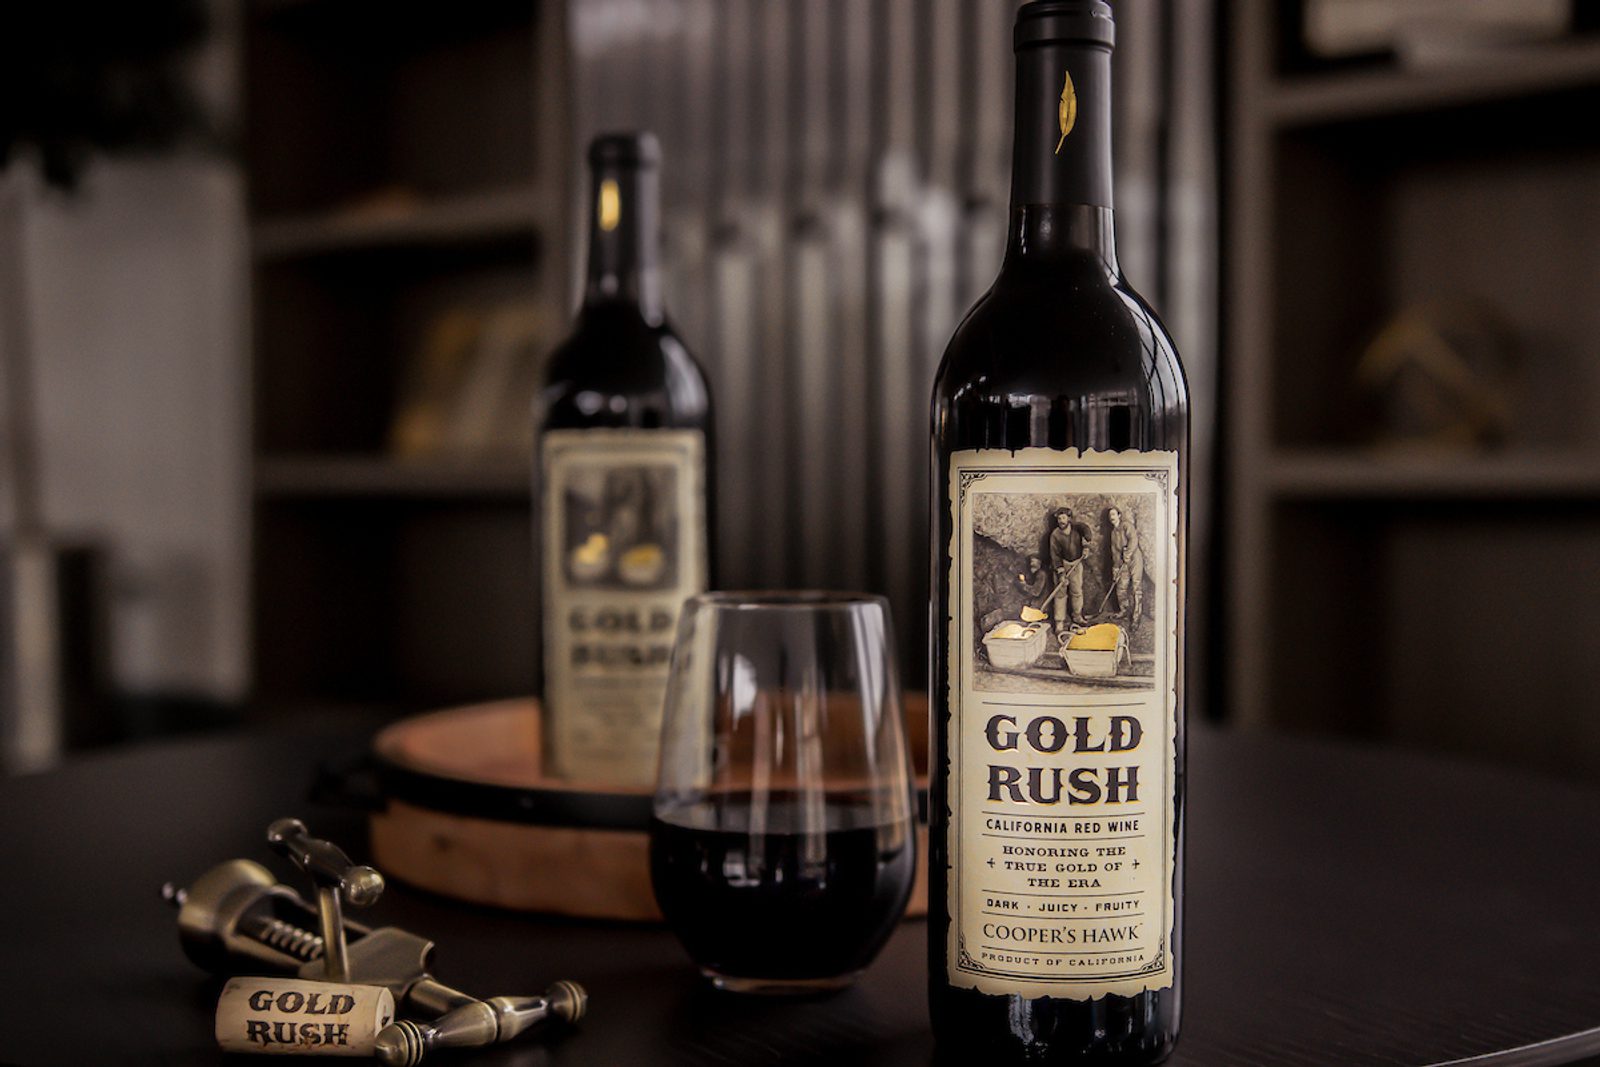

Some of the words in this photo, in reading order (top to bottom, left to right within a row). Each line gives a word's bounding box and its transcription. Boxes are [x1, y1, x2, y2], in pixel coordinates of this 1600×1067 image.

[984, 714, 1144, 753] GOLD
[986, 764, 1140, 805] RUSH
[986, 818, 1068, 834] CALIFORNIA
[1074, 822, 1101, 833] RED
[1108, 820, 1139, 832] WINE
[1002, 845, 1090, 857] HONORING
[1096, 846, 1126, 856] THE
[1004, 861, 1047, 872] TRUE
[1055, 863, 1097, 873] GOLD
[1104, 862, 1123, 871] OF
[1028, 878, 1060, 888] THE
[1068, 878, 1102, 888] ERA
[987, 898, 1019, 910] DARK
[1039, 903, 1078, 912] JUICY
[1096, 900, 1140, 912] FRUITY
[983, 923, 1076, 944] COOPER'S
[1083, 925, 1139, 943] HAWK
[981, 952, 1040, 966] PRODUCT
[1046, 958, 1061, 966] OF
[1069, 954, 1144, 966] CALIFORNIA
[248, 990, 356, 1015] GOLD
[247, 1020, 350, 1046] RUSH
